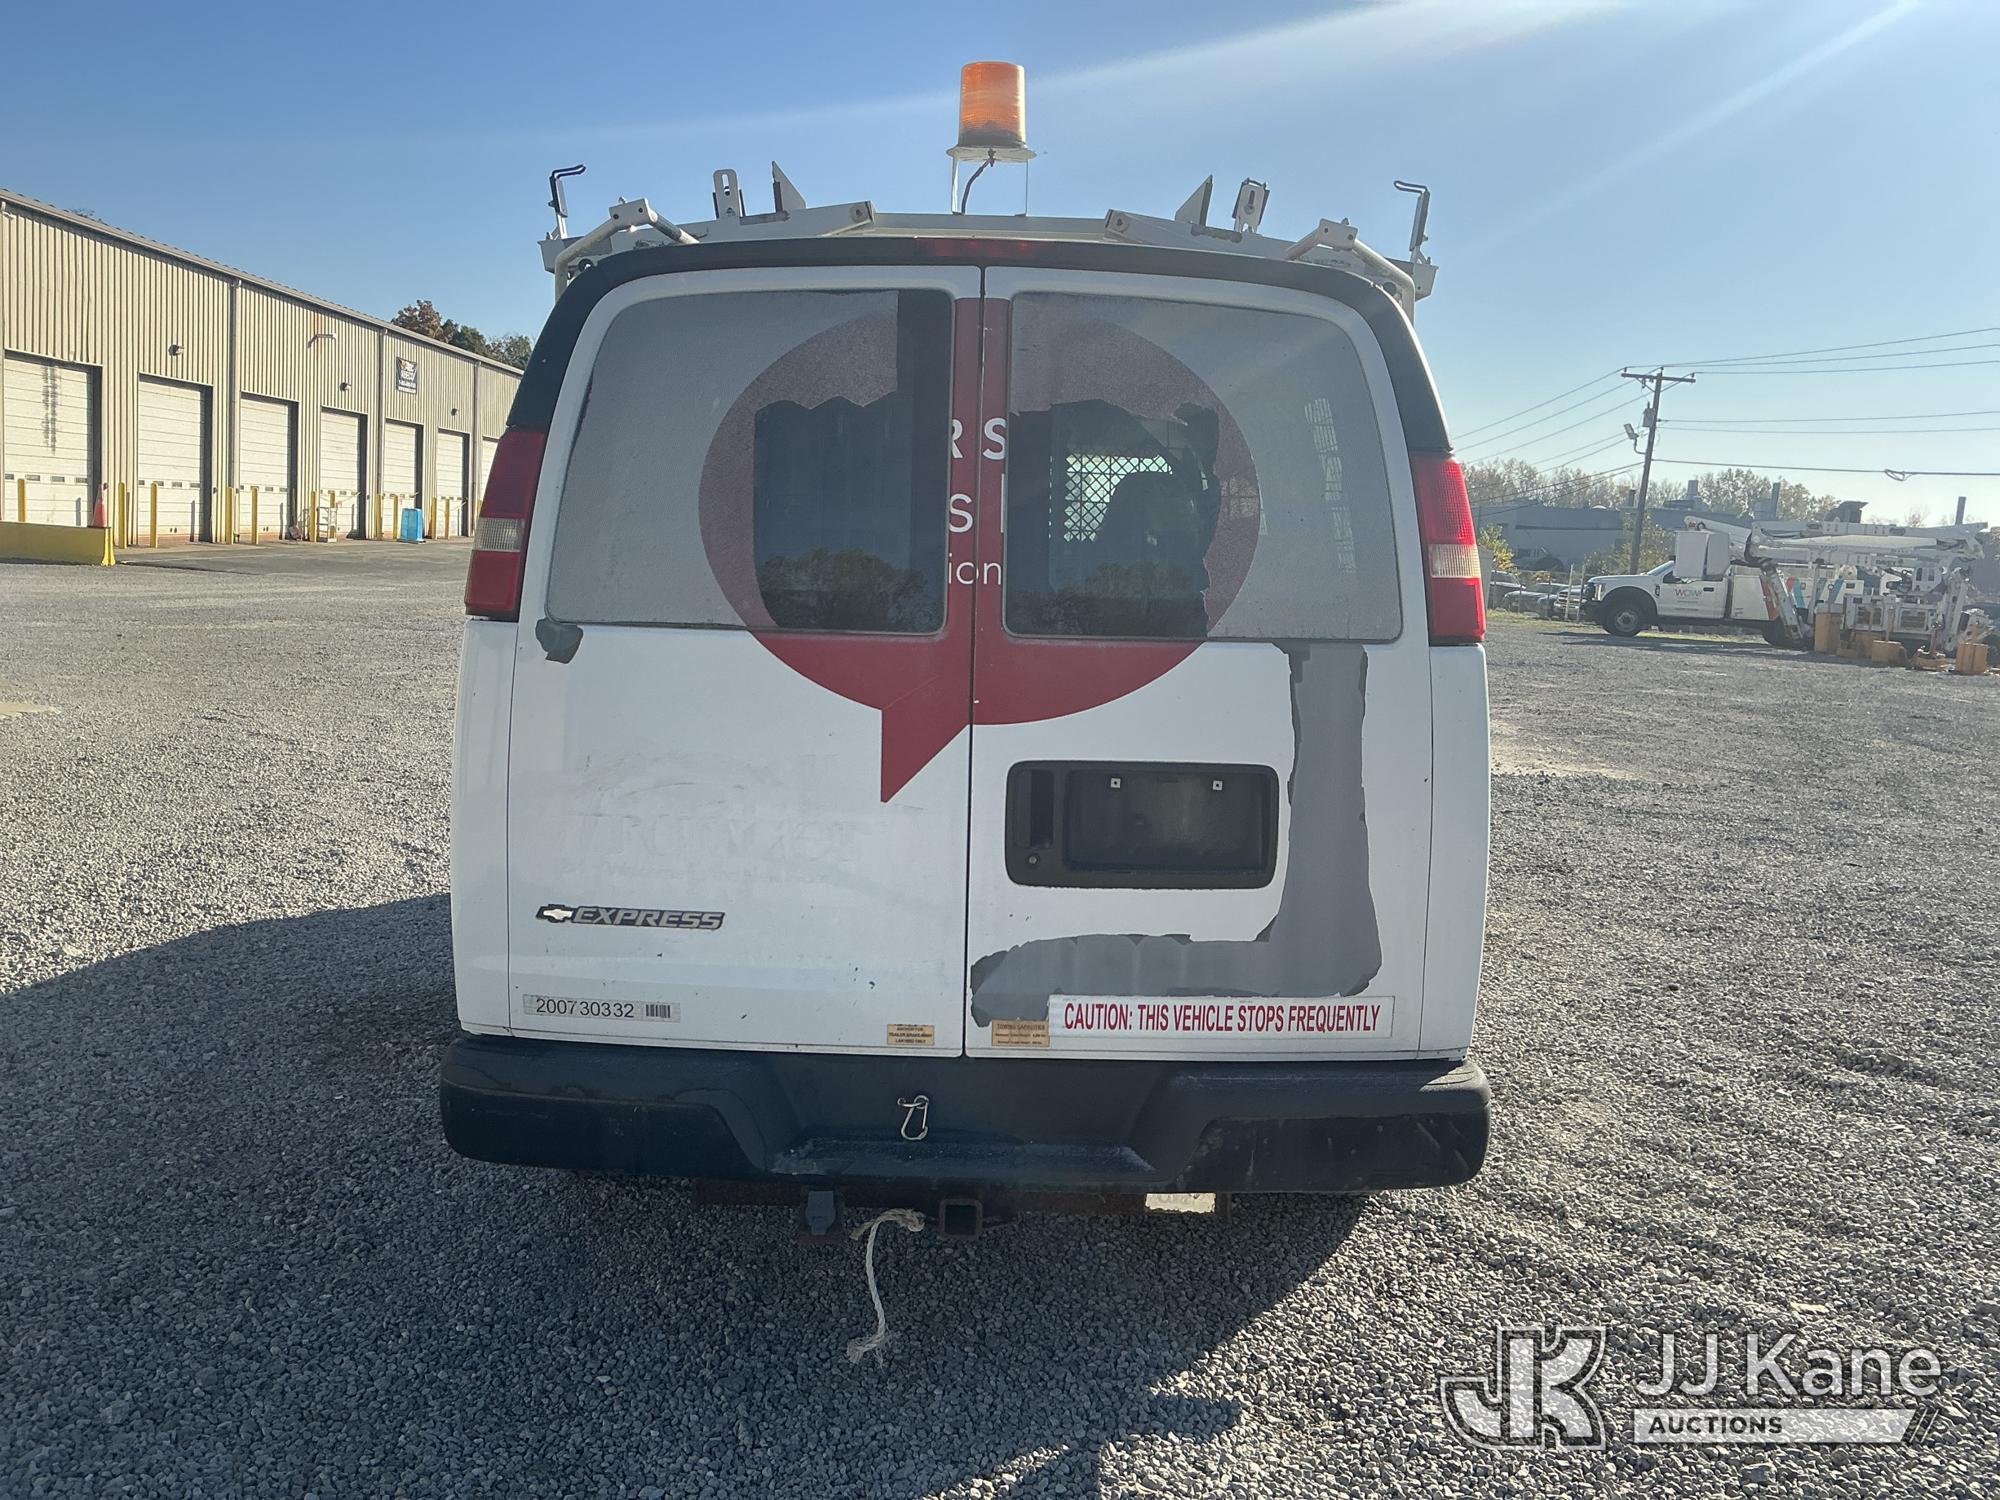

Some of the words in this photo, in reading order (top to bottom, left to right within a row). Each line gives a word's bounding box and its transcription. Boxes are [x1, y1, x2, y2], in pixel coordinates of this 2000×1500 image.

[573, 906, 725, 930] EXPRESS
[536, 998, 634, 1018] 200730332
[1064, 1002, 1133, 1030] CAUTION:
[1137, 1004, 1169, 1031] THIS
[1174, 1004, 1234, 1032] VEHICLE
[1237, 1004, 1284, 1032] STOPS
[1288, 1004, 1381, 1033] FREQUENTLY
